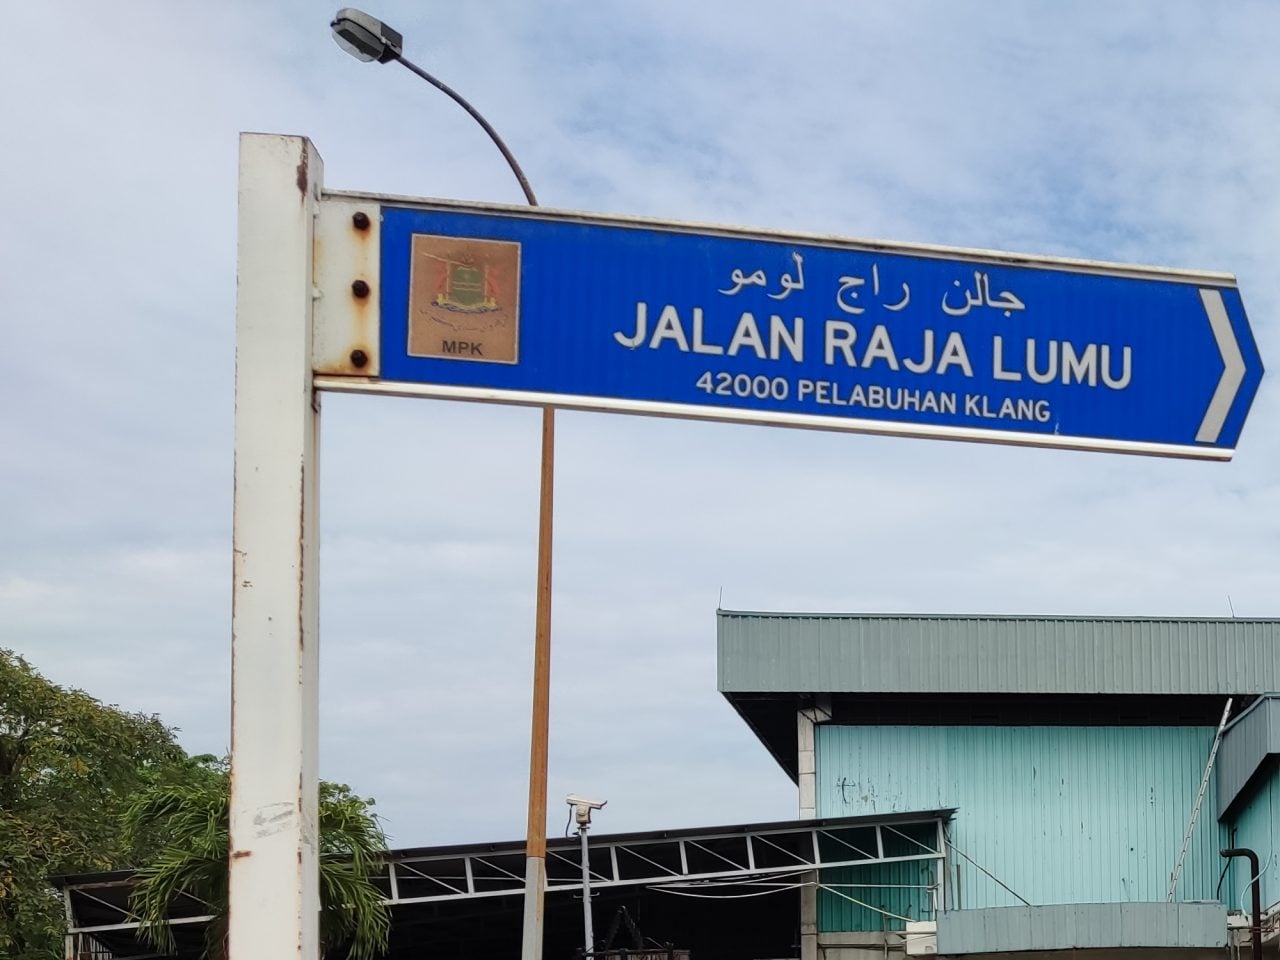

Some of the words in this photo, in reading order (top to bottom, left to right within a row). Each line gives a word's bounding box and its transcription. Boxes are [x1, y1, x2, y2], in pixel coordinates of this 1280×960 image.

[837, 264, 910, 314] راج
[942, 271, 1025, 317] جالن
[442, 340, 483, 356] MPK
[614, 302, 804, 362] JALAN
[825, 320, 973, 377] RAJA
[993, 335, 1132, 389] LUMU
[696, 371, 788, 400] 42000
[798, 379, 956, 414] PELABUHAN
[965, 394, 1050, 422] KLANG
